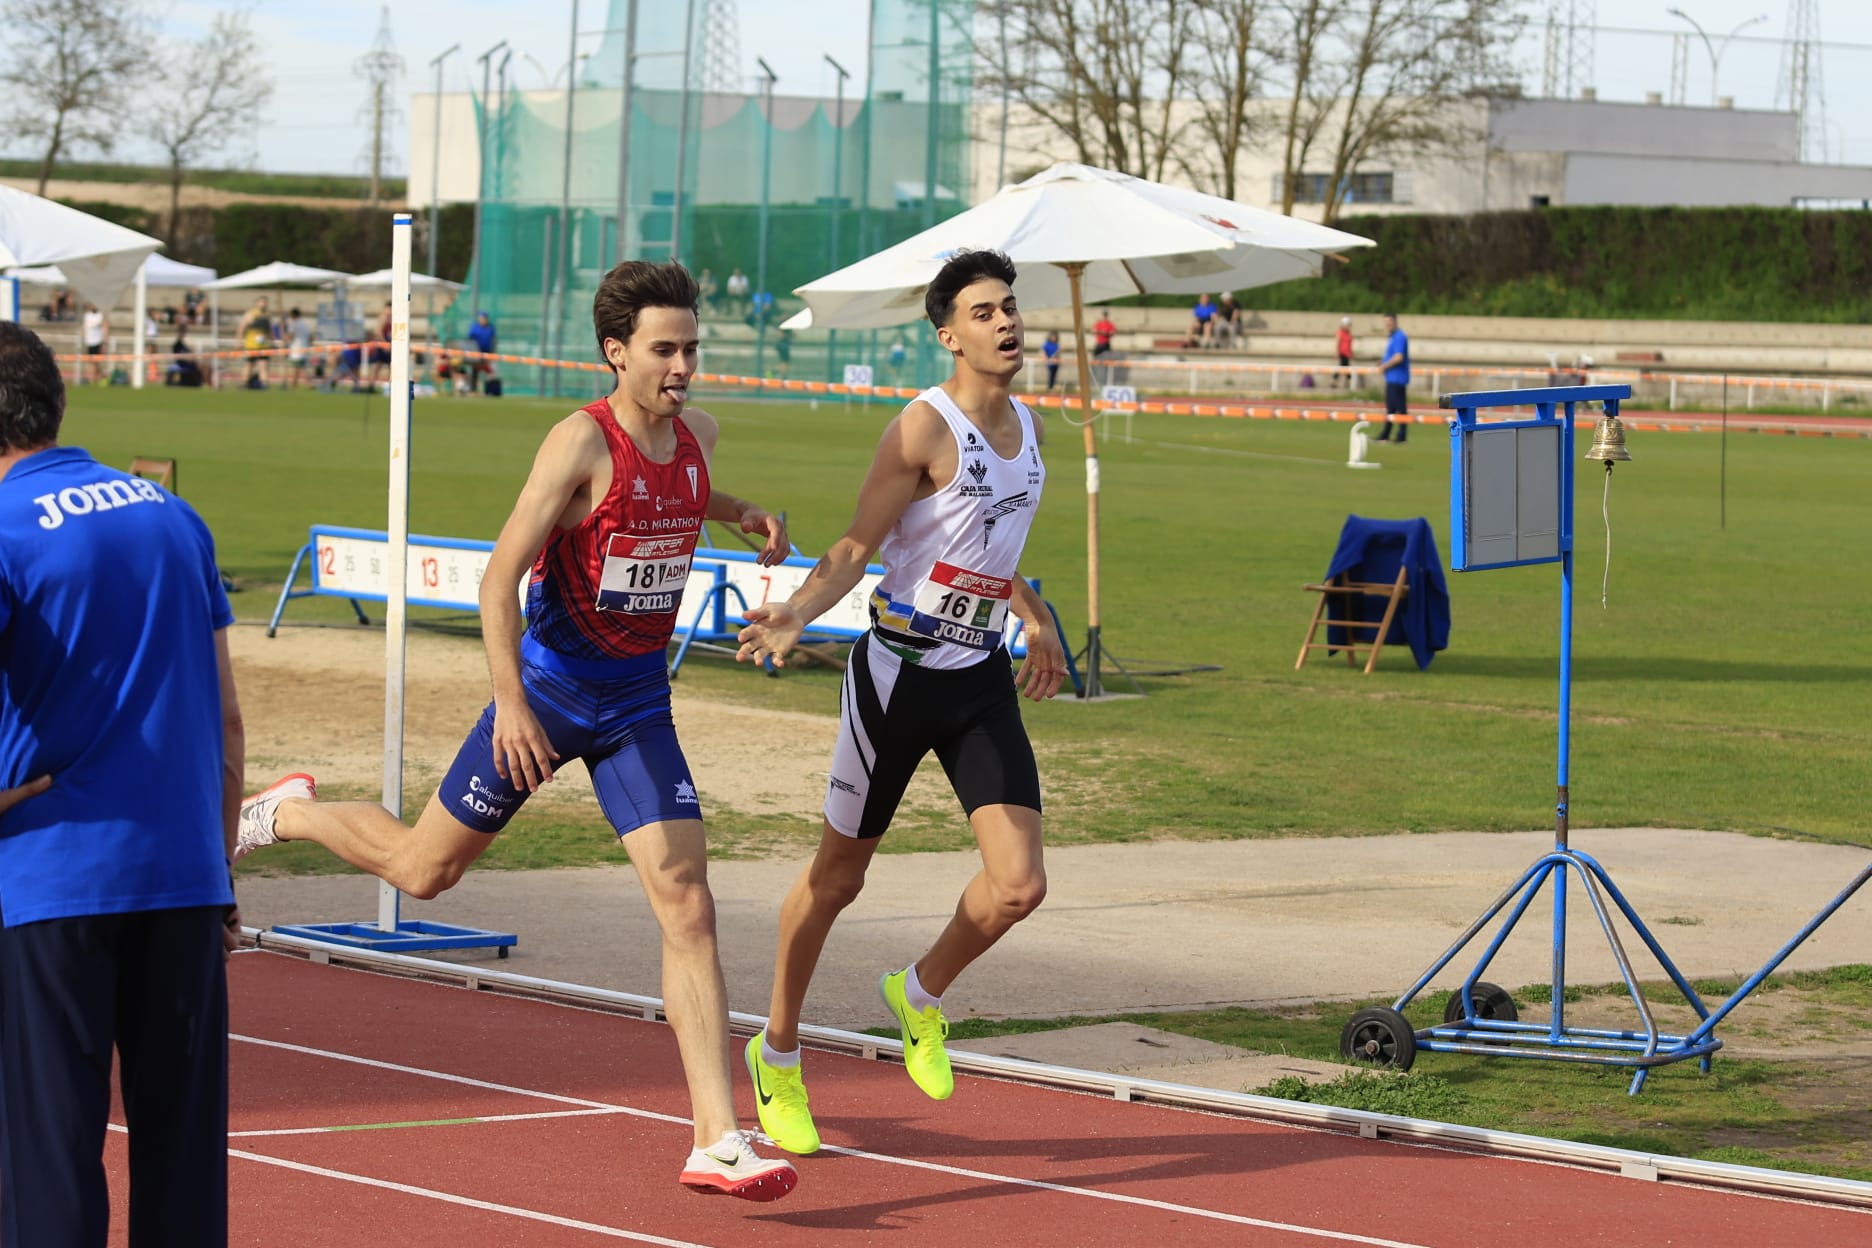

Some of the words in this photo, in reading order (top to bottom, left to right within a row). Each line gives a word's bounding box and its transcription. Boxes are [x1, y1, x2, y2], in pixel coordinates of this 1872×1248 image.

[848, 367, 869, 386] 30
[1107, 389, 1132, 402] 50
[33, 478, 165, 530] Joma
[652, 517, 700, 531] MARATHON
[318, 547, 335, 575] 12
[421, 557, 439, 587] 13
[626, 563, 655, 588] 18
[666, 563, 686, 578] ADM
[624, 594, 672, 611] Joma
[760, 575, 771, 606] 7
[941, 592, 970, 618] 16
[933, 621, 984, 646] Joma
[462, 792, 504, 818] ADM
